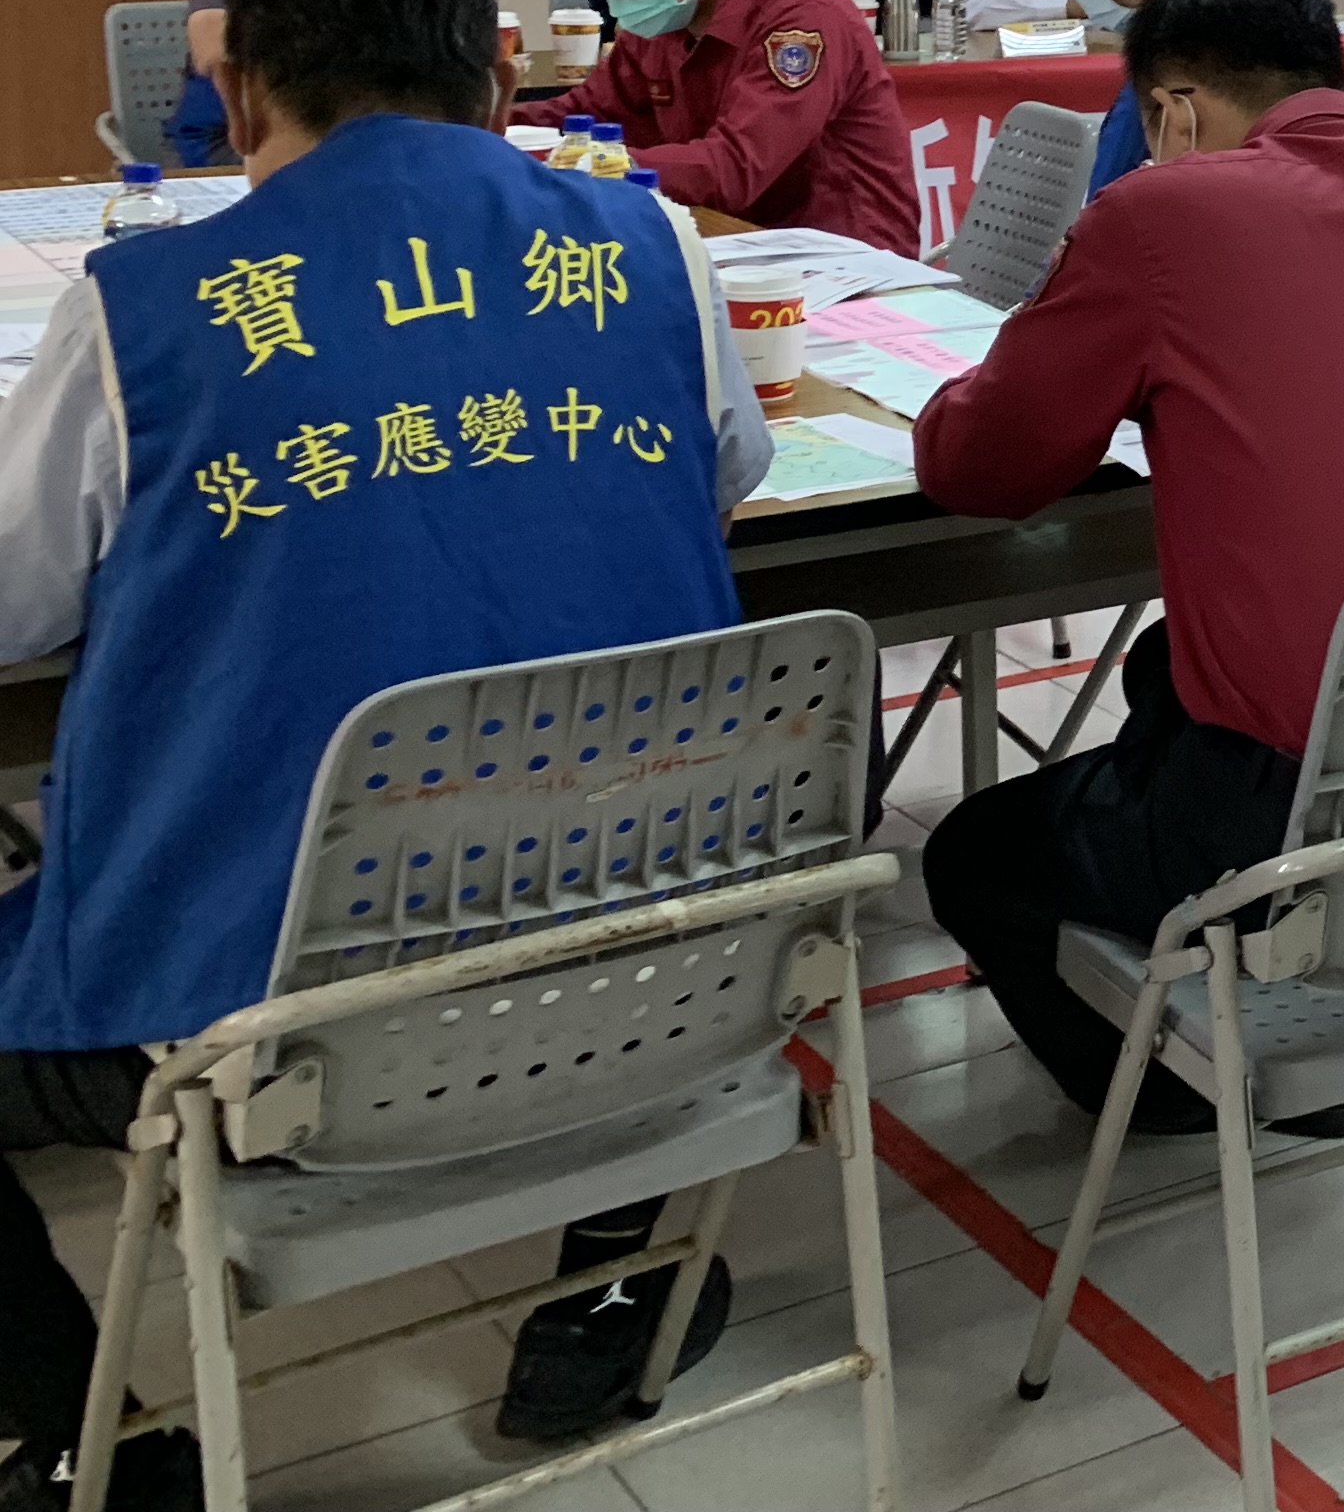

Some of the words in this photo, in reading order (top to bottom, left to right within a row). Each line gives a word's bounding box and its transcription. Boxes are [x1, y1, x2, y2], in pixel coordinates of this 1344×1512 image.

[197, 228, 628, 376] 寶山鄉
[196, 386, 673, 538] 災害應變中心
